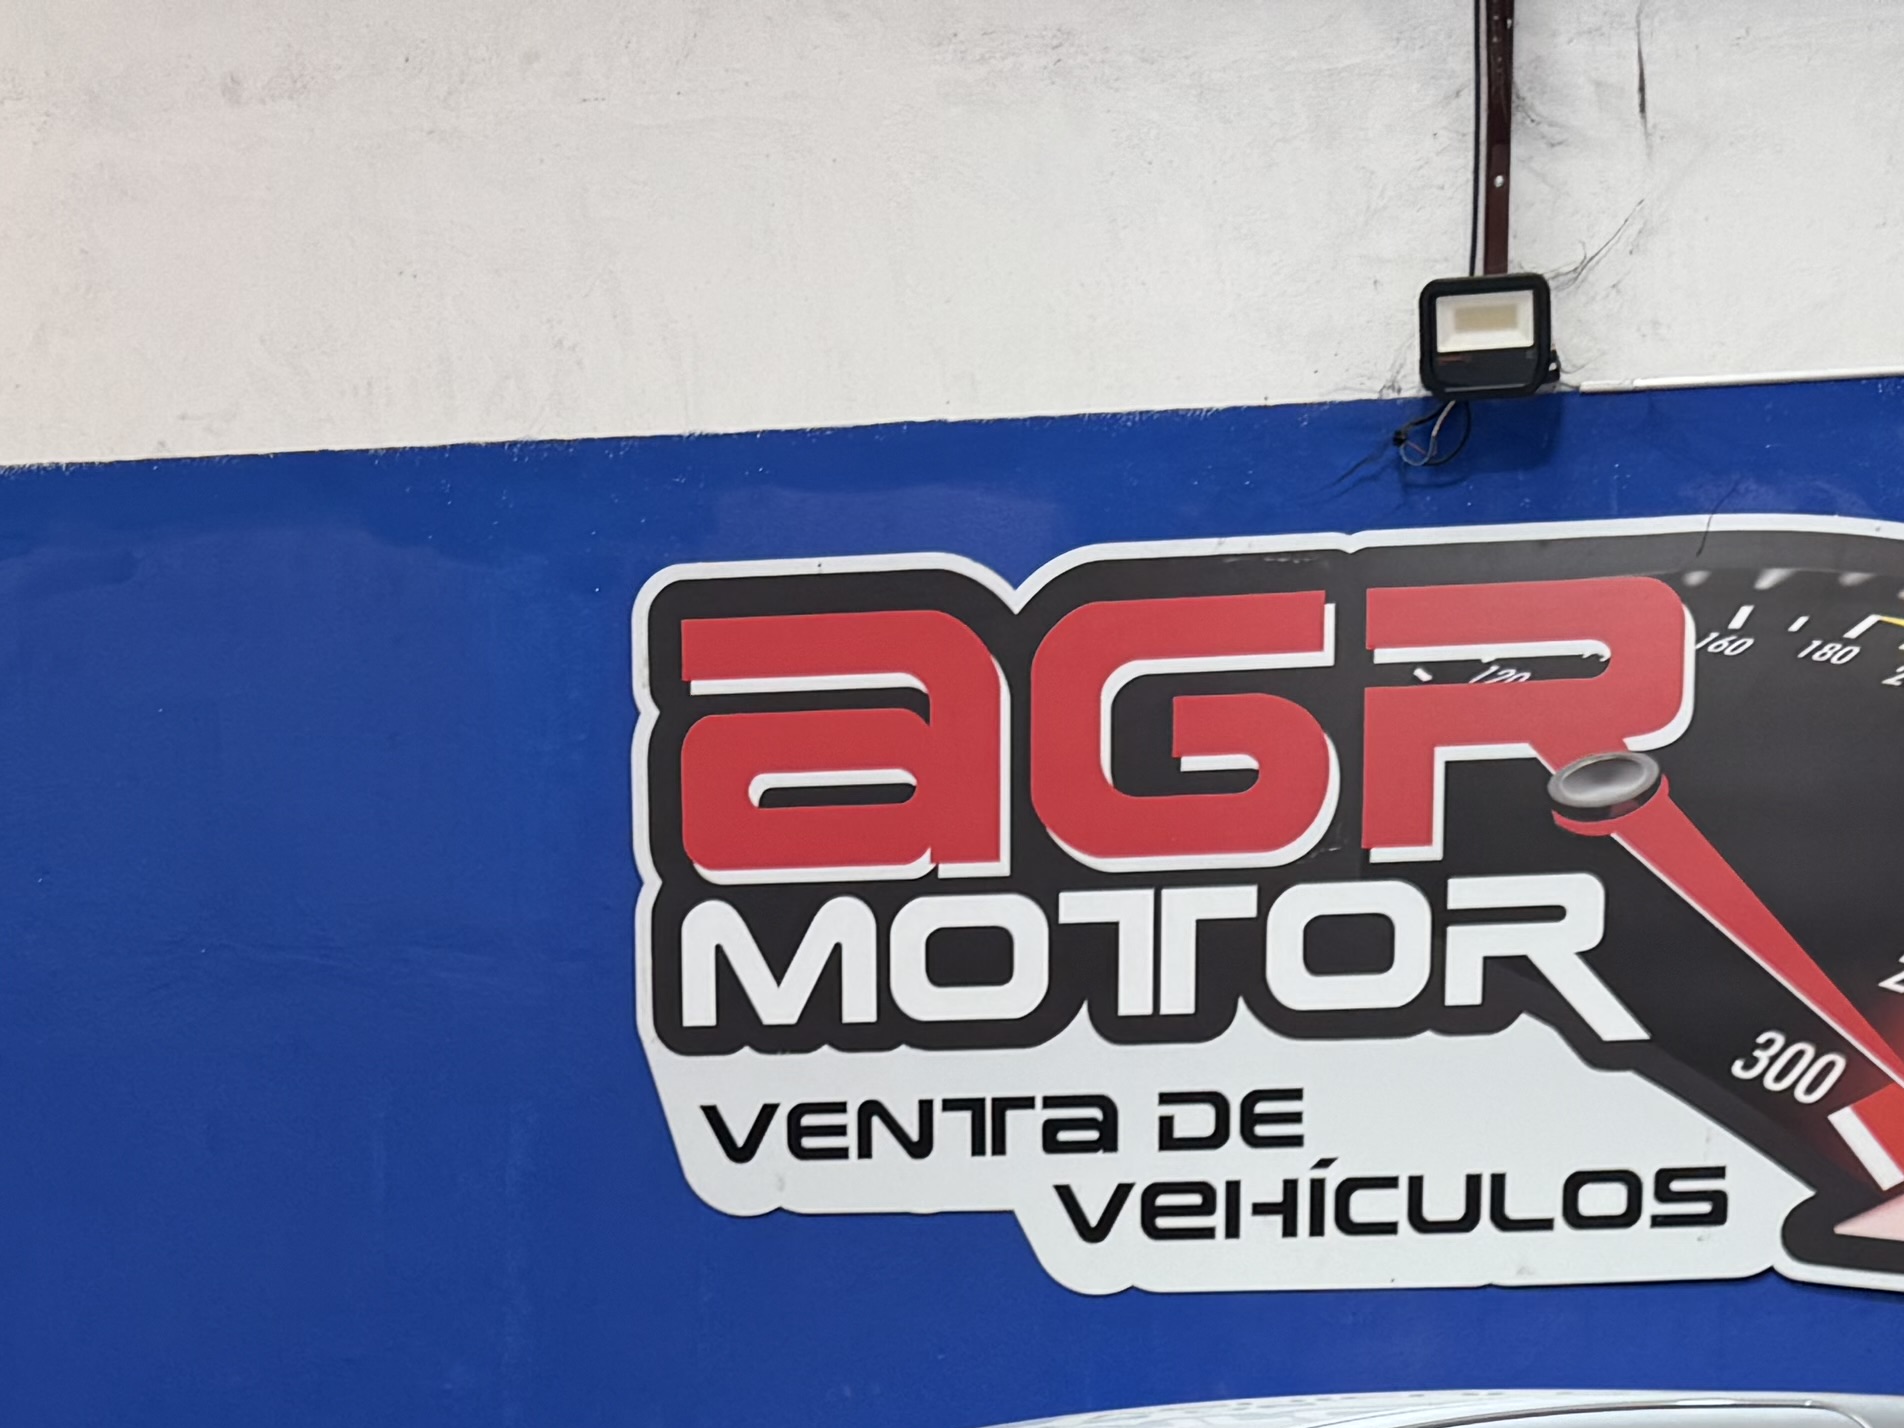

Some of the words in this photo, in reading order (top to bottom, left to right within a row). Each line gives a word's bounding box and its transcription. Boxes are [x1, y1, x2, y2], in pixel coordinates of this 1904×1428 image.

[1696, 631, 1756, 657] 160
[1797, 638, 1861, 666] 180
[681, 871, 1651, 1042] MOTOR
[1729, 1030, 1847, 1105] 300
[1157, 1086, 1306, 1153] DE
